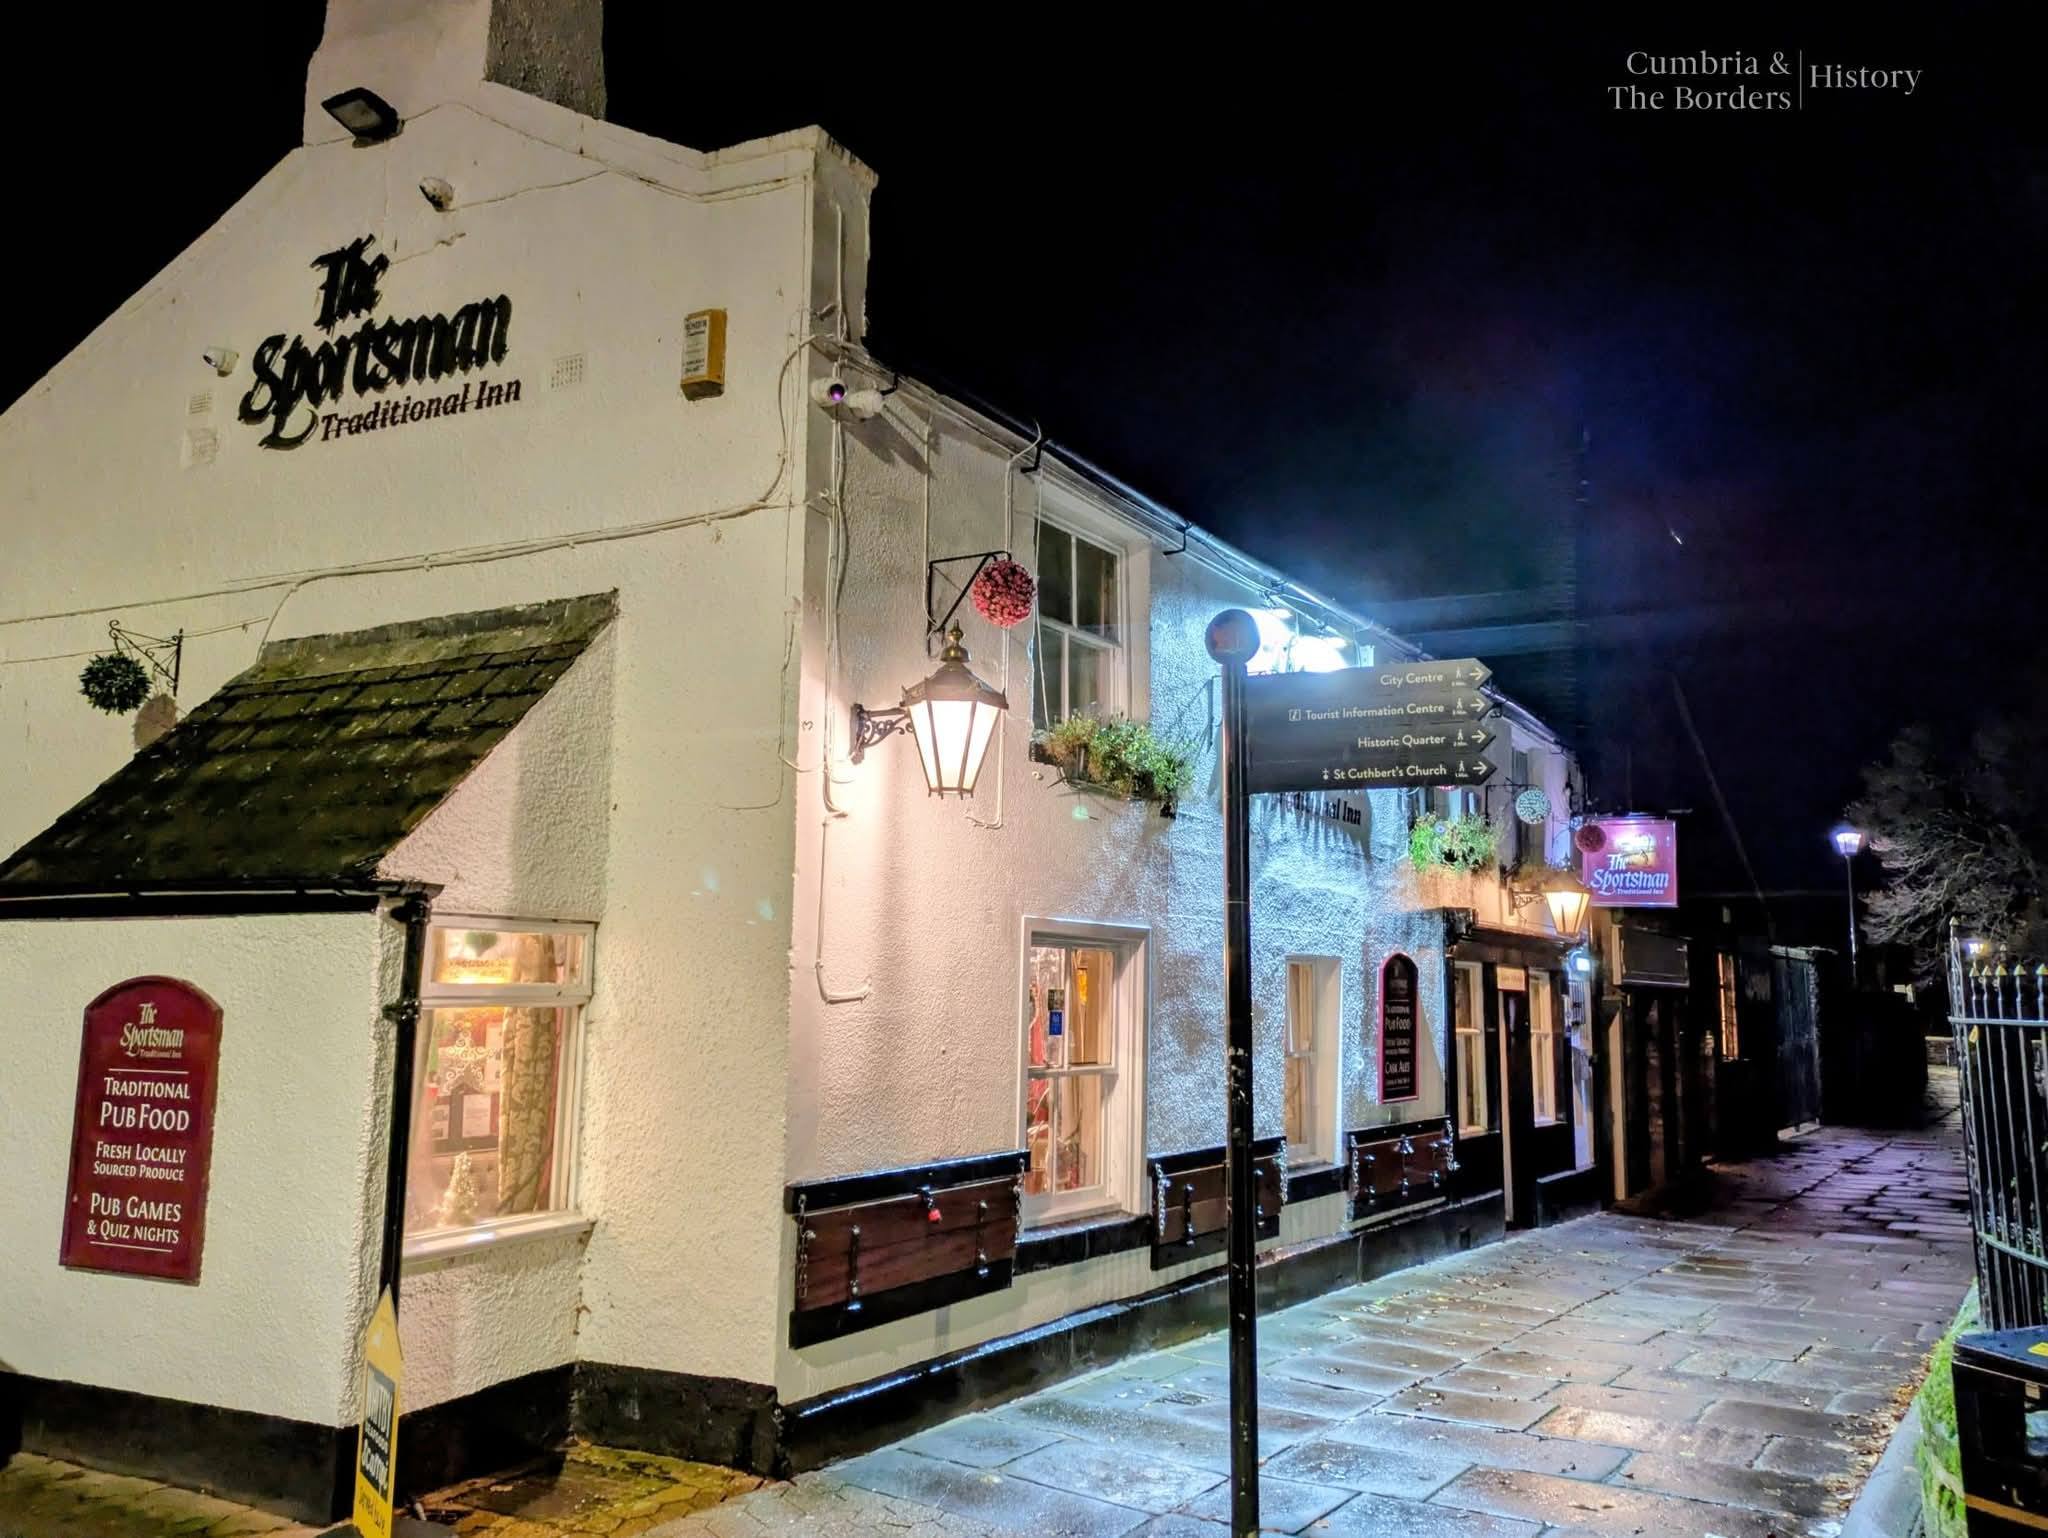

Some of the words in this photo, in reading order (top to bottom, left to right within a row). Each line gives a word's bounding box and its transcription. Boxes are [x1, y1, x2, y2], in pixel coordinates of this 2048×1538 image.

[311, 234, 390, 336] The
[238, 294, 512, 450] Sportsman
[320, 383, 470, 442] Traditional
[474, 379, 522, 410] Inn
[1380, 675, 1403, 688] City
[1406, 673, 1443, 685] Centre
[1305, 709, 1339, 721] Tourist
[1342, 706, 1404, 718] Information
[1406, 703, 1445, 715] Centre
[1358, 737, 1399, 748] Historic
[1402, 735, 1446, 748] Quarter
[1333, 769, 1345, 780] St
[1348, 766, 1404, 780] Cuthbert's
[1406, 764, 1447, 777] Church
[1343, 800, 1362, 825] Inn
[1607, 852, 1628, 871] The
[1590, 868, 1670, 896] Sportsman
[139, 1002, 157, 1025] The
[119, 1022, 184, 1057] Sportsman
[104, 1077, 190, 1099] TRADITIONAL
[100, 1101, 136, 1128] PUB
[139, 1103, 190, 1131] FOOD
[96, 1141, 131, 1160] FRESH
[136, 1144, 186, 1163] LOCALLY
[93, 1161, 136, 1177] SOURCED
[139, 1164, 184, 1181] PRODUCE
[90, 1192, 120, 1216] PUB
[126, 1196, 181, 1222] GAMES
[87, 1219, 97, 1235] &
[100, 1220, 130, 1240] QUIZ
[133, 1225, 179, 1244] NIGHTS
